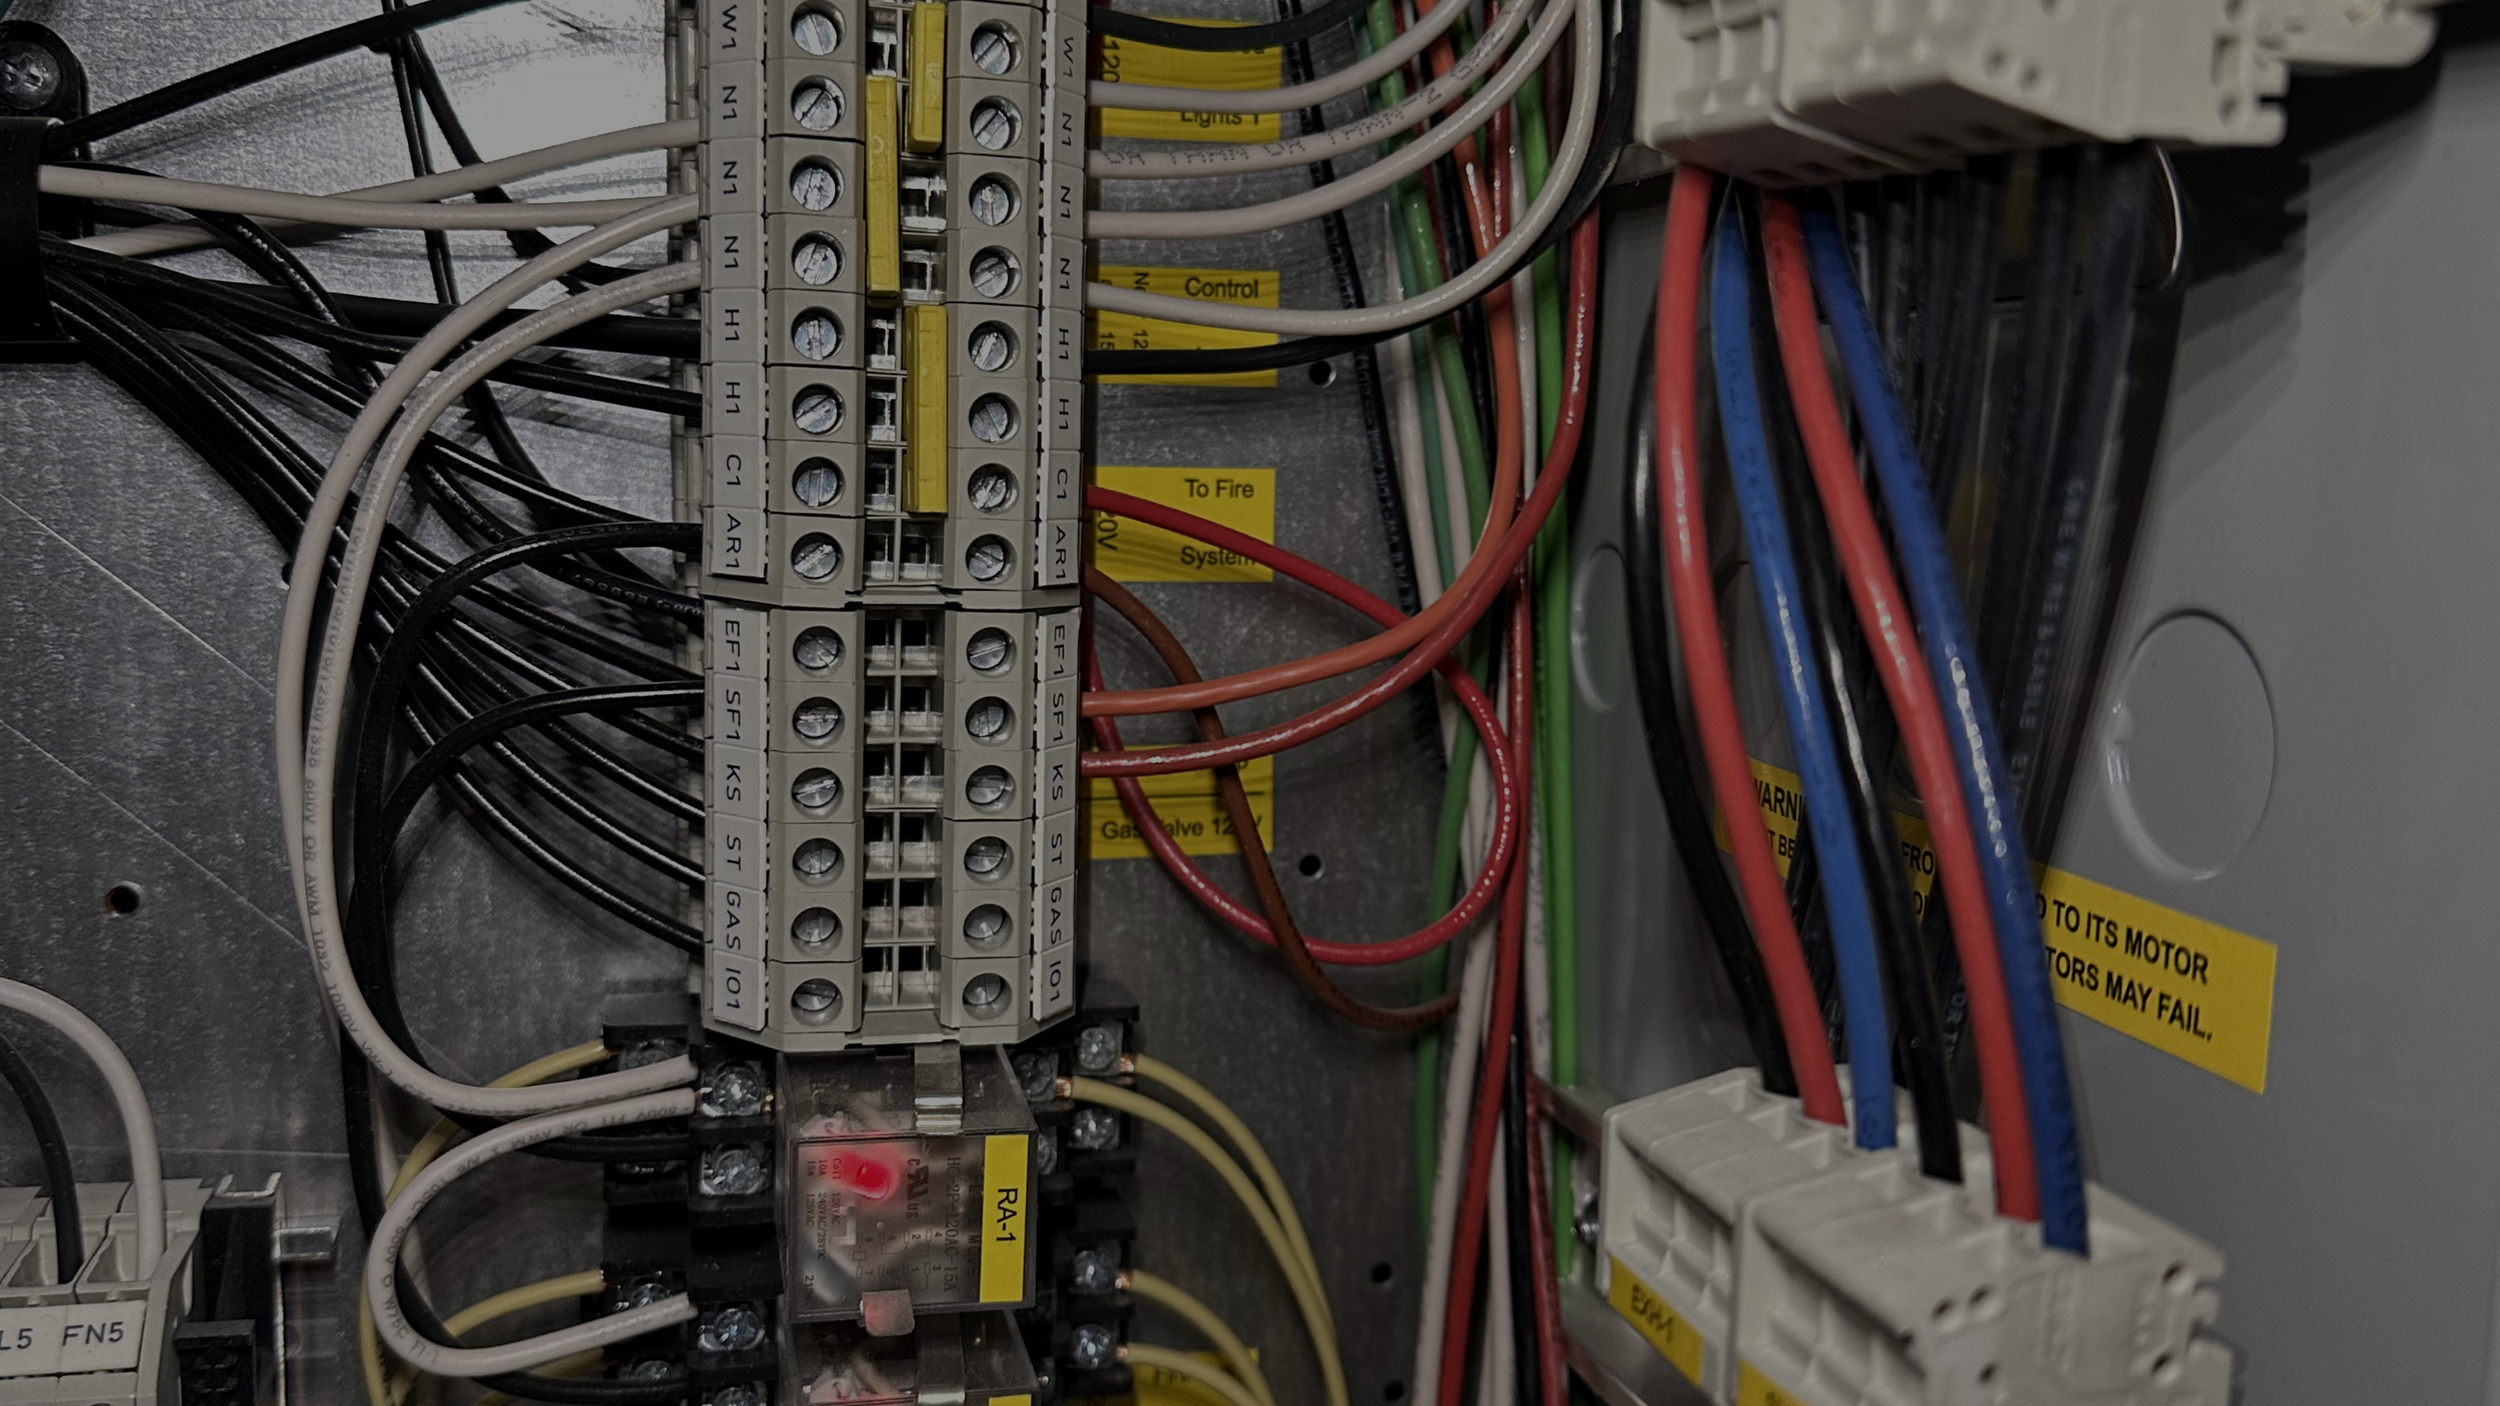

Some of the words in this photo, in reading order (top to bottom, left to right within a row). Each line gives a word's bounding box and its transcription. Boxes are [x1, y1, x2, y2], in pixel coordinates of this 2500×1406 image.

[722, 4, 737, 50] W1
[1063, 36, 1075, 78] W1
[722, 85, 738, 120] N1
[1062, 112, 1073, 146] N1
[723, 161, 738, 195] N1
[1061, 185, 1072, 219] N1
[724, 236, 739, 269] N1
[1060, 257, 1071, 290] N1
[1185, 277, 1259, 298] Control
[725, 309, 740, 341] H1
[1058, 328, 1070, 360] H1
[726, 382, 741, 414] H1
[1058, 398, 1070, 430] H1
[726, 454, 741, 486] C1
[1056, 468, 1069, 500] C1
[1185, 478, 1209, 498] To
[1216, 479, 1255, 498] Fire
[726, 513, 741, 568] AR1
[1055, 525, 1067, 579] AR1
[725, 620, 741, 671] EF1
[1054, 624, 1065, 676] EF1
[726, 689, 741, 740] SF1
[1053, 693, 1064, 742] SF1
[726, 764, 741, 802] KS
[1052, 763, 1064, 801] KS
[1161, 819, 1204, 837] alve
[726, 834, 742, 872] ST
[1051, 833, 1063, 866] ST
[1901, 840, 1935, 876] FRO
[307, 874, 321, 918] AWM
[726, 890, 742, 950] GAS
[1050, 886, 1062, 945] GAS
[2053, 899, 2080, 933] TO
[2086, 911, 2118, 949] ITS
[2125, 926, 2208, 986] MOTOR
[2045, 946, 2099, 991] TORS
[2105, 970, 2152, 1014] MAY
[2157, 991, 2213, 1042] FAIL.
[831, 1157, 842, 1181] Coil
[830, 1192, 841, 1226] 120VAC
[996, 1187, 1019, 1244] RA-1
[62, 1321, 124, 1347] FN5
